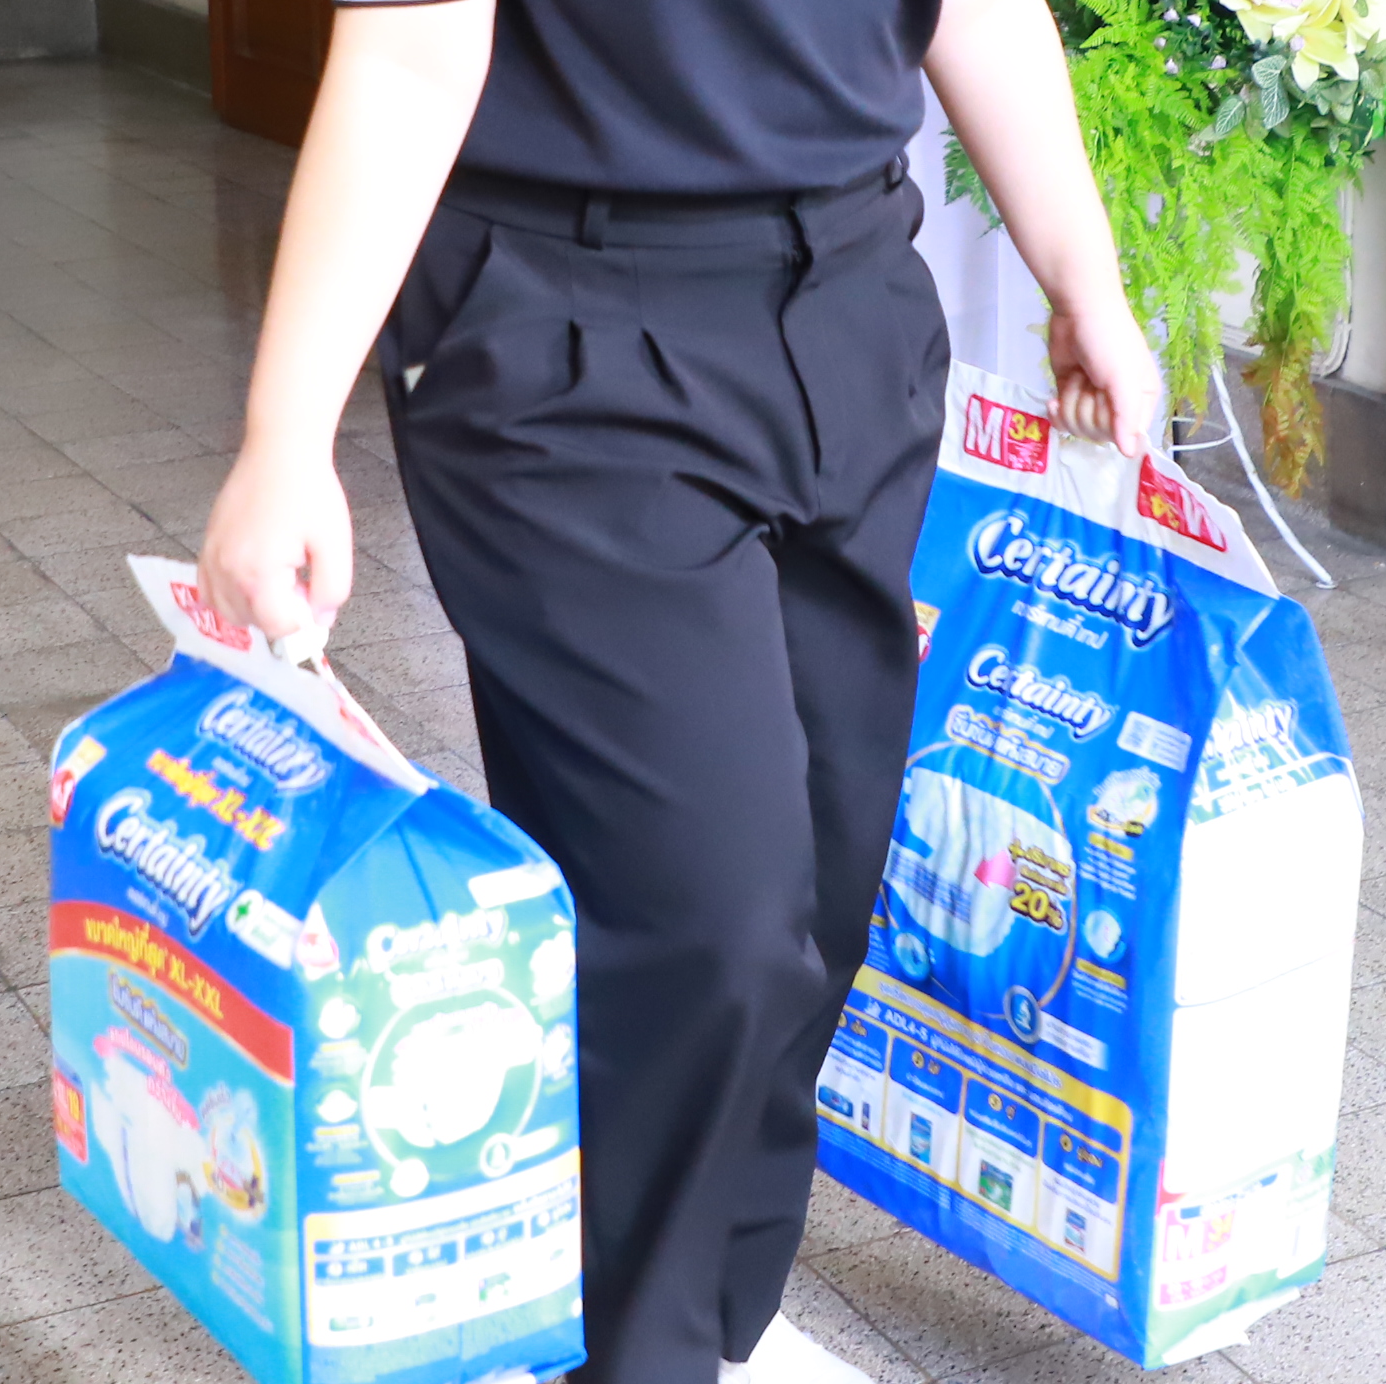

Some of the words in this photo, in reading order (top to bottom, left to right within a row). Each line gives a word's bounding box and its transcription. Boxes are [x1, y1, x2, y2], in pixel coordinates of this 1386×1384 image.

[965, 395, 1004, 461] M
[1008, 412, 1043, 442] 34
[970, 514, 1175, 649] Certainty
[96, 790, 238, 936] Certainty
[1010, 881, 1064, 932] 20%
[168, 954, 224, 1021] XL-XXL
